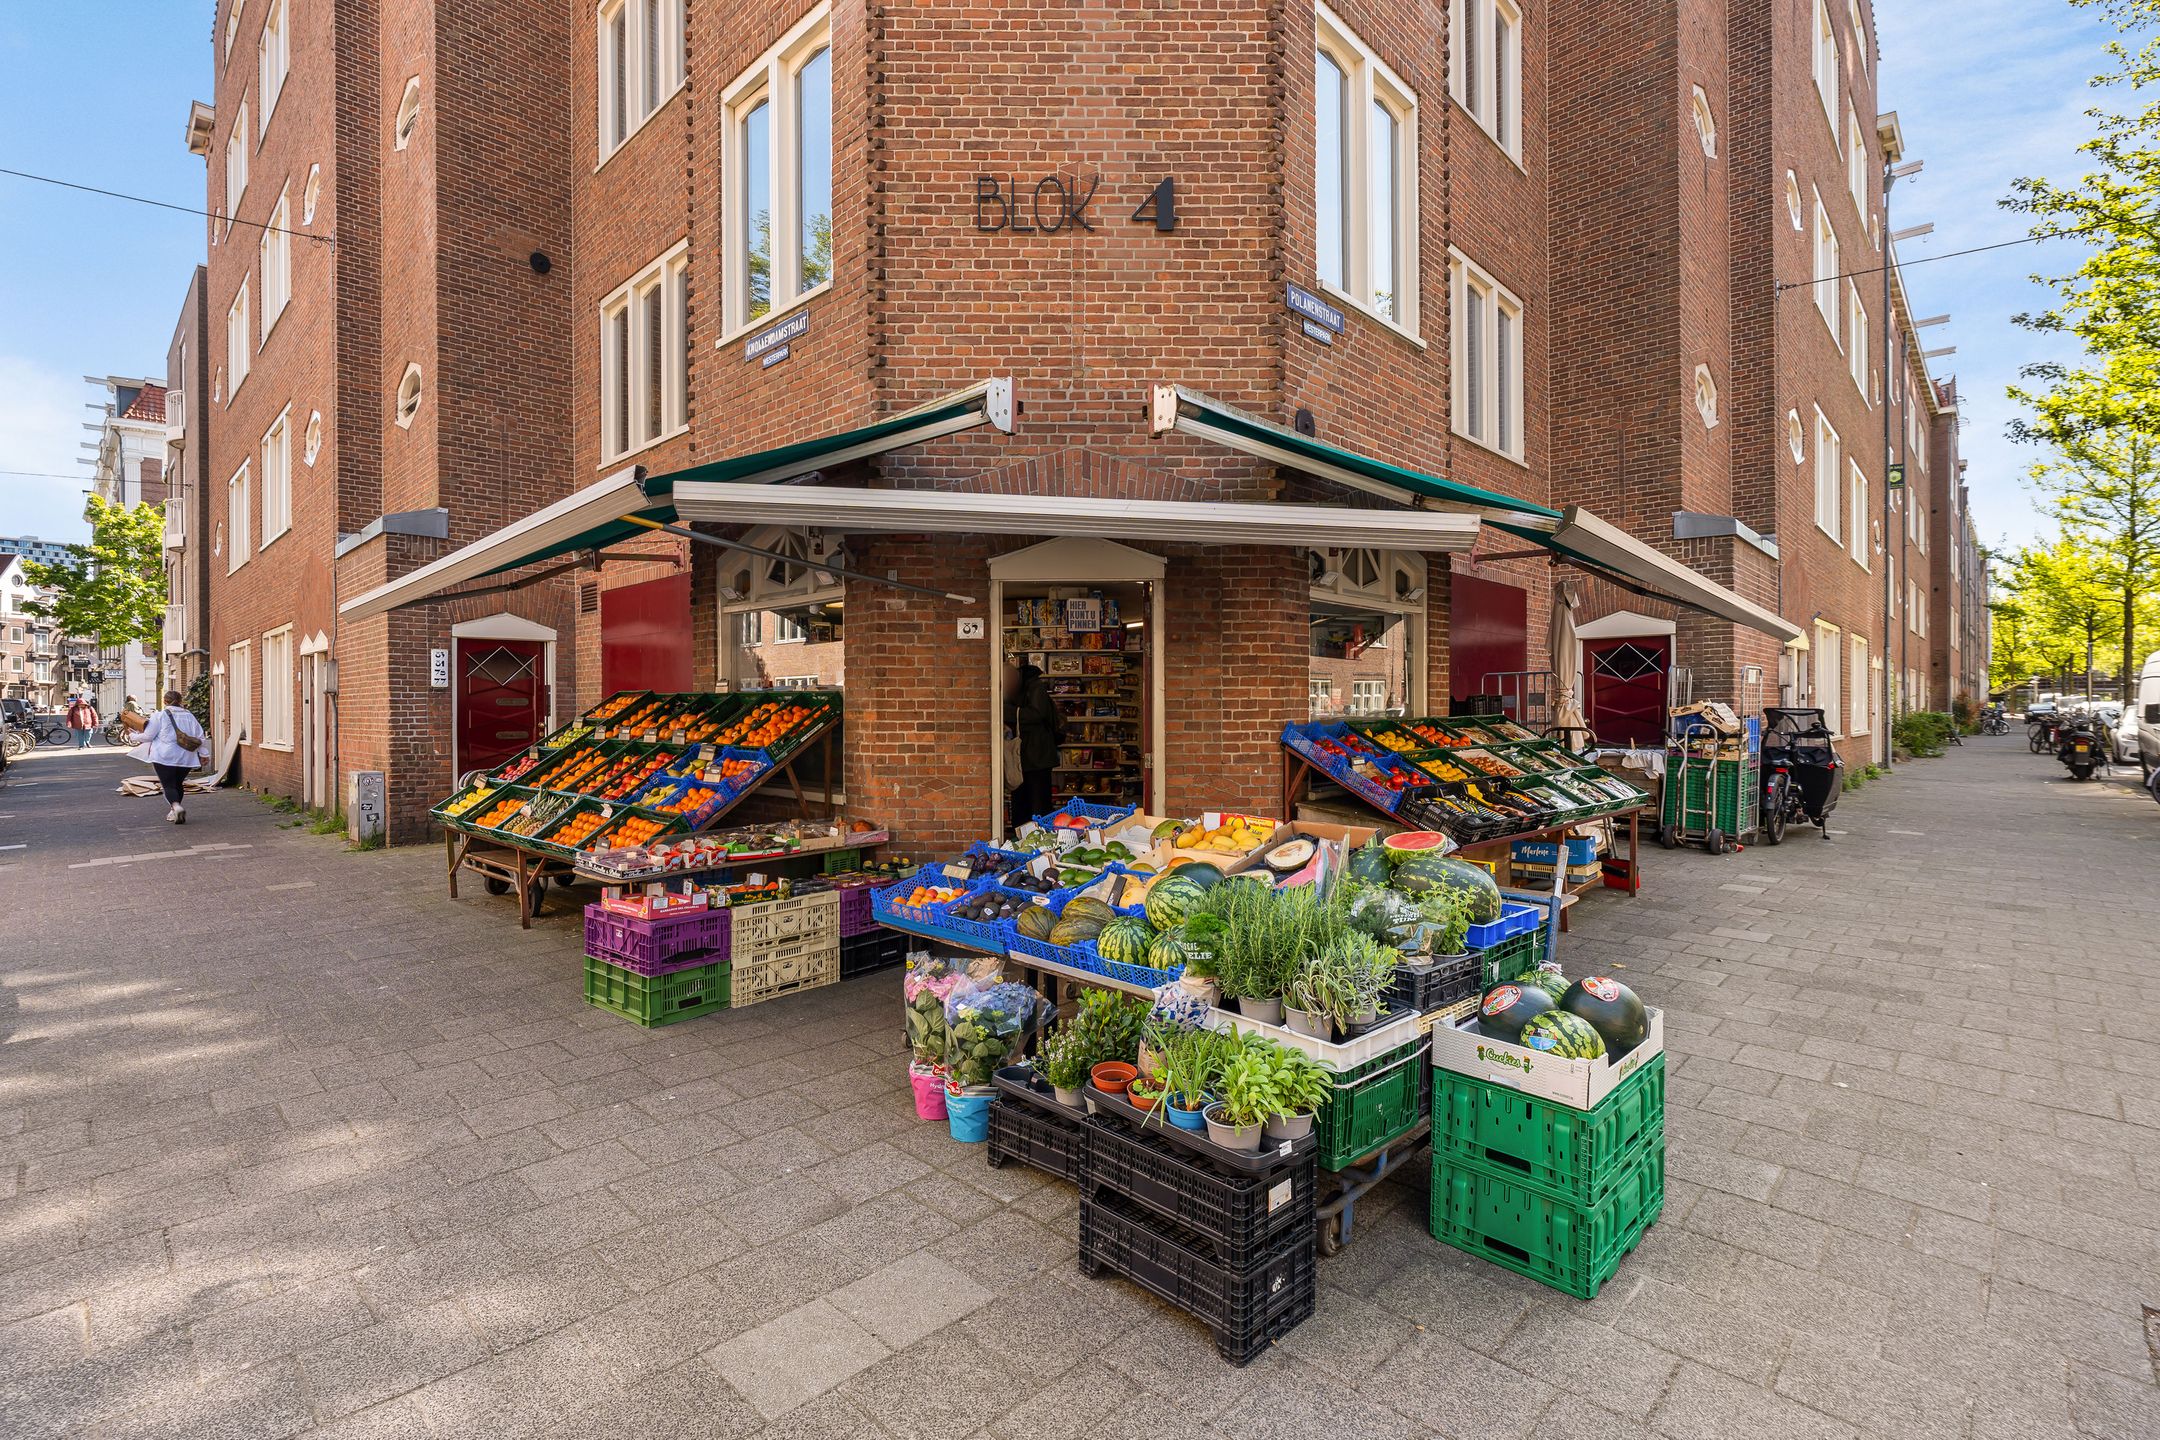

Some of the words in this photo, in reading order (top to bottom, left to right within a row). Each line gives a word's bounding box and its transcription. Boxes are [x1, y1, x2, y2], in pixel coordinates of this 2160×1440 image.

[977, 176, 1099, 232] BLOK
[1132, 177, 1179, 231] 4
[1290, 290, 1341, 328] POLANENSTRAAT
[746, 316, 807, 357] KNOLLENDAMSTRAAT
[1070, 600, 1087, 610] HIER
[1070, 610, 1090, 620] KUNT
[1090, 610, 1096, 620] U
[1070, 620, 1097, 629] PINNEN
[1188, 951, 1213, 960] ELIE
[1486, 1048, 1522, 1069] Cuckies
